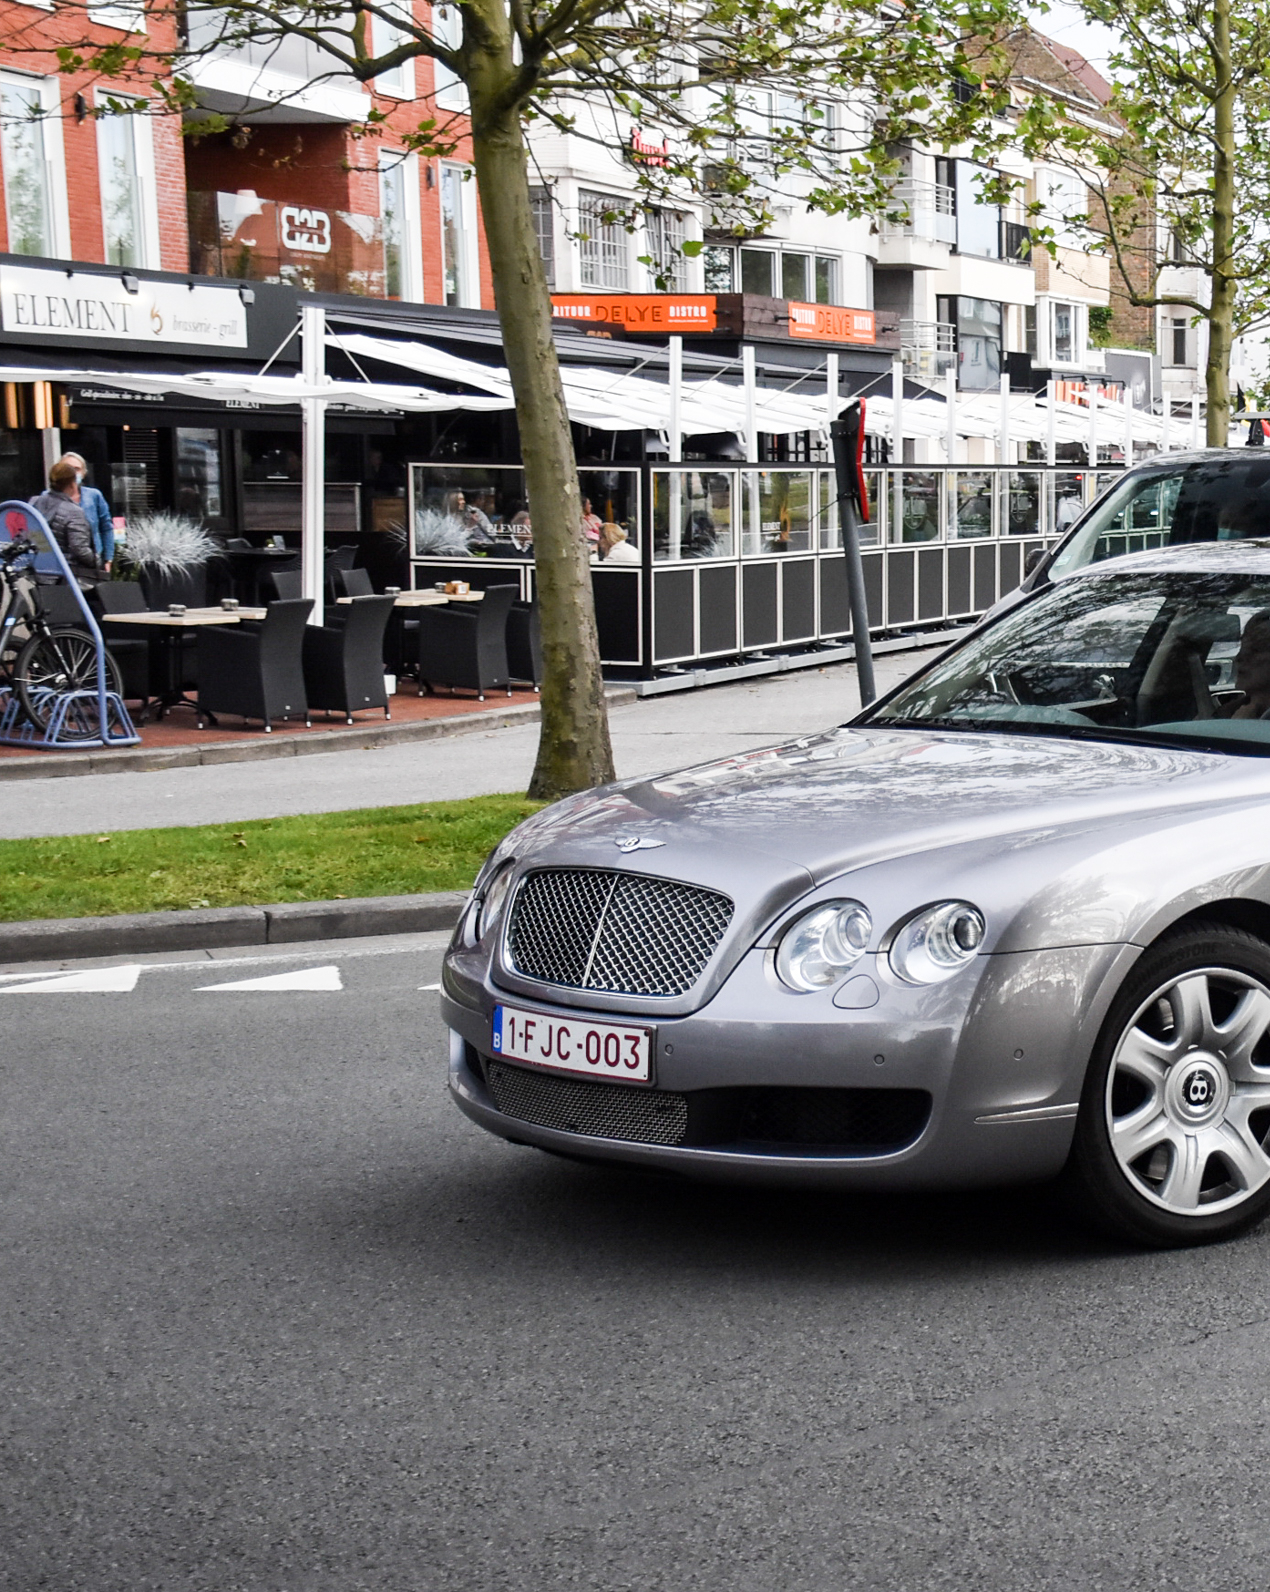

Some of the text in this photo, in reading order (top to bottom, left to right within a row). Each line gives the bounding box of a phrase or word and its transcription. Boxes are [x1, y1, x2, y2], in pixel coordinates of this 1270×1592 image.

[13, 293, 131, 333] ELEMENT
[219, 319, 238, 339] grill
[552, 305, 707, 322] RITOUR DELYE BISTRO
[818, 311, 851, 336] DELYE
[486, 523, 532, 534] ELEMEN
[493, 1032, 501, 1048] B
[509, 1017, 640, 1069] 1-FJC-003
